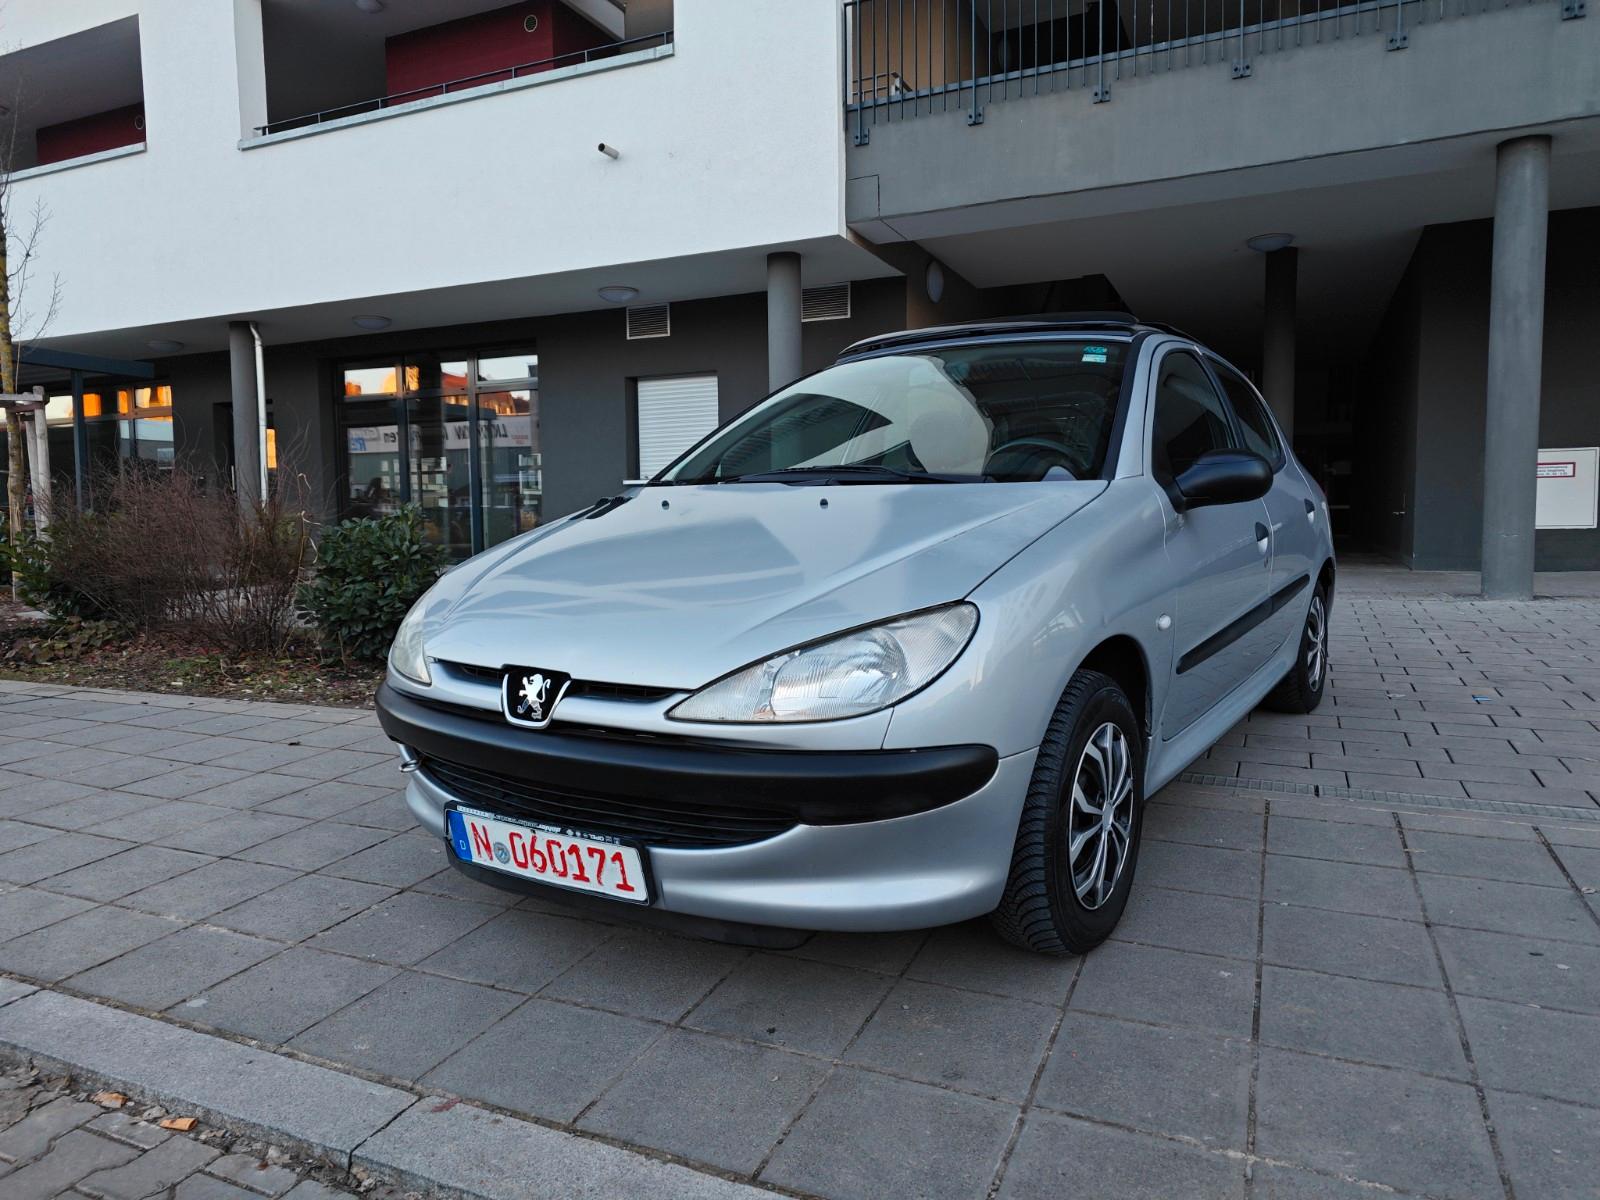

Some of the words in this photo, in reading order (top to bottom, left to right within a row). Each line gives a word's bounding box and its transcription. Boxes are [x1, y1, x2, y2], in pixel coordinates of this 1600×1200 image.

[459, 839, 467, 850] D
[471, 822, 494, 861] N
[509, 831, 635, 892] 060171
